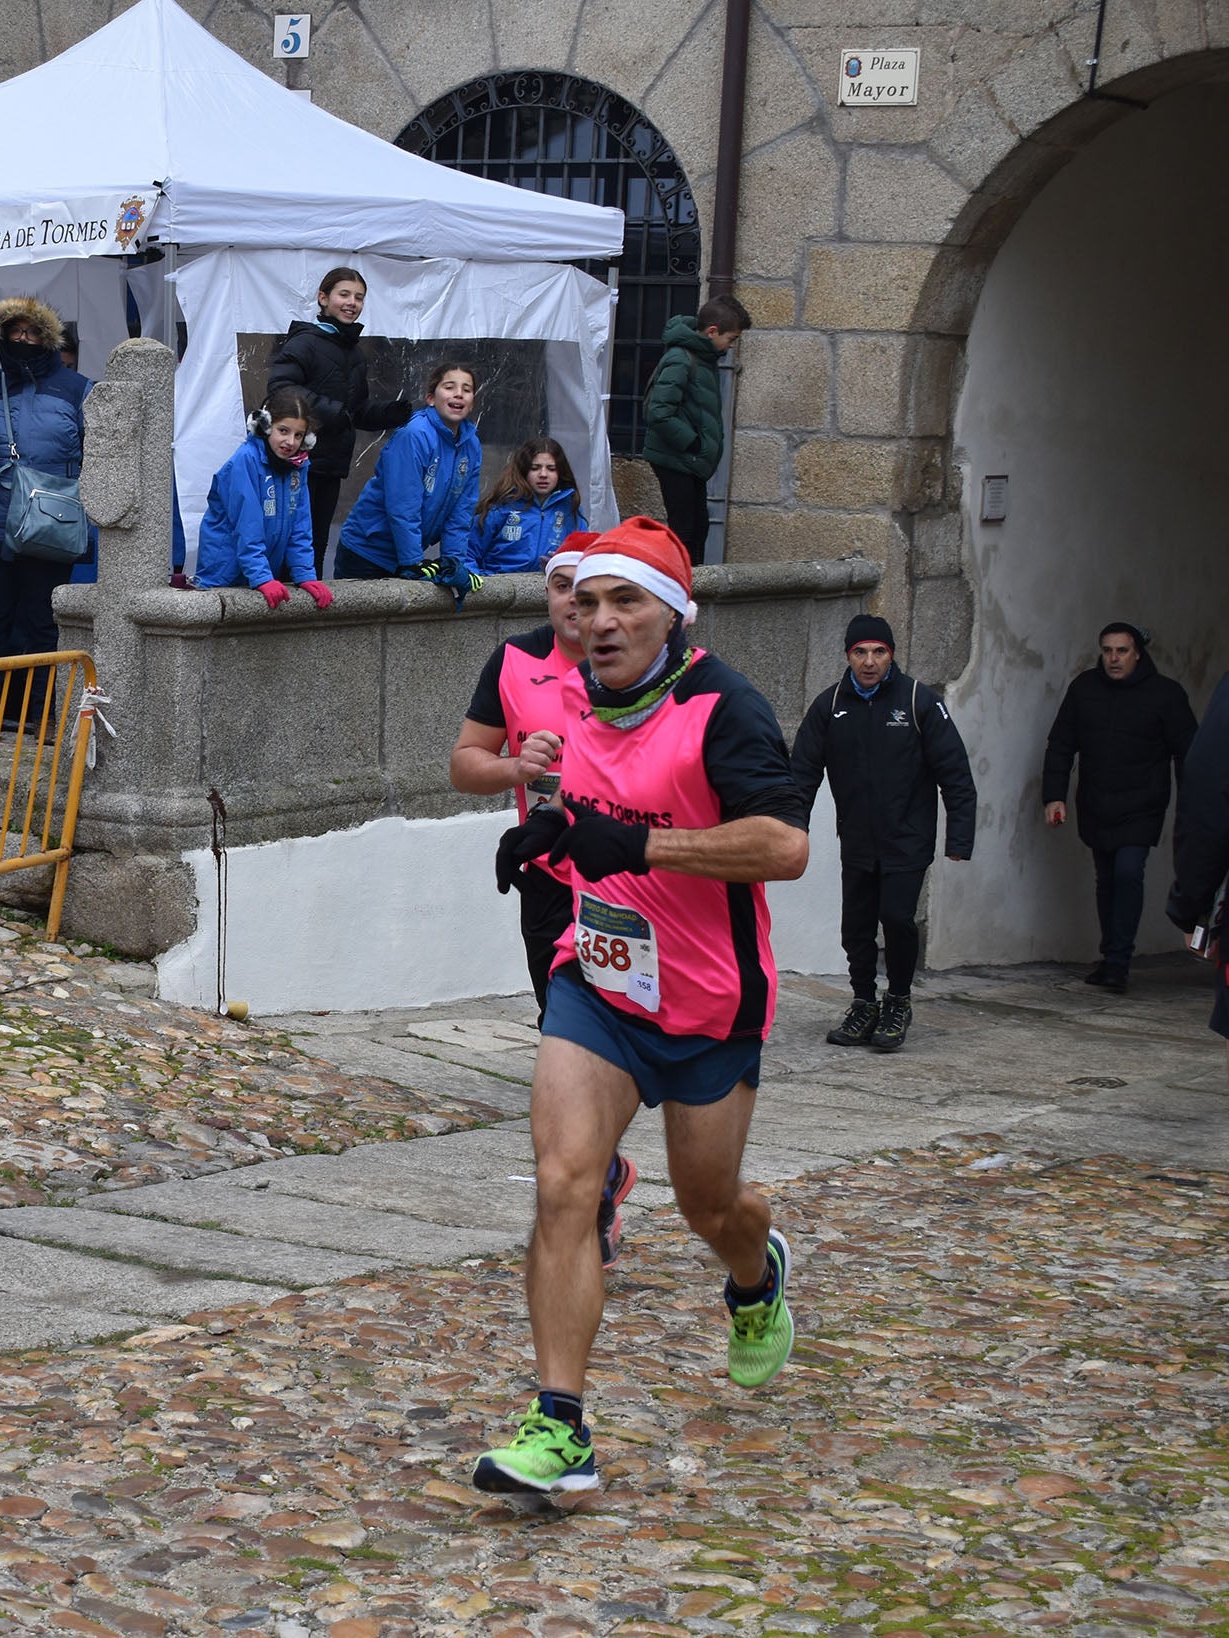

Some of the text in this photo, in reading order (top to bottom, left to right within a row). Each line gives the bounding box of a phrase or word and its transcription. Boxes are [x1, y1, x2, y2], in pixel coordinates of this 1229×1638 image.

[280, 17, 303, 54] 5
[870, 57, 906, 70] Plaza
[847, 82, 909, 101] Mayor
[15, 226, 36, 248] DE
[40, 219, 108, 246] TORMES
[605, 800, 673, 829] TORMES
[580, 930, 631, 971] 358
[636, 980, 652, 991] 358
